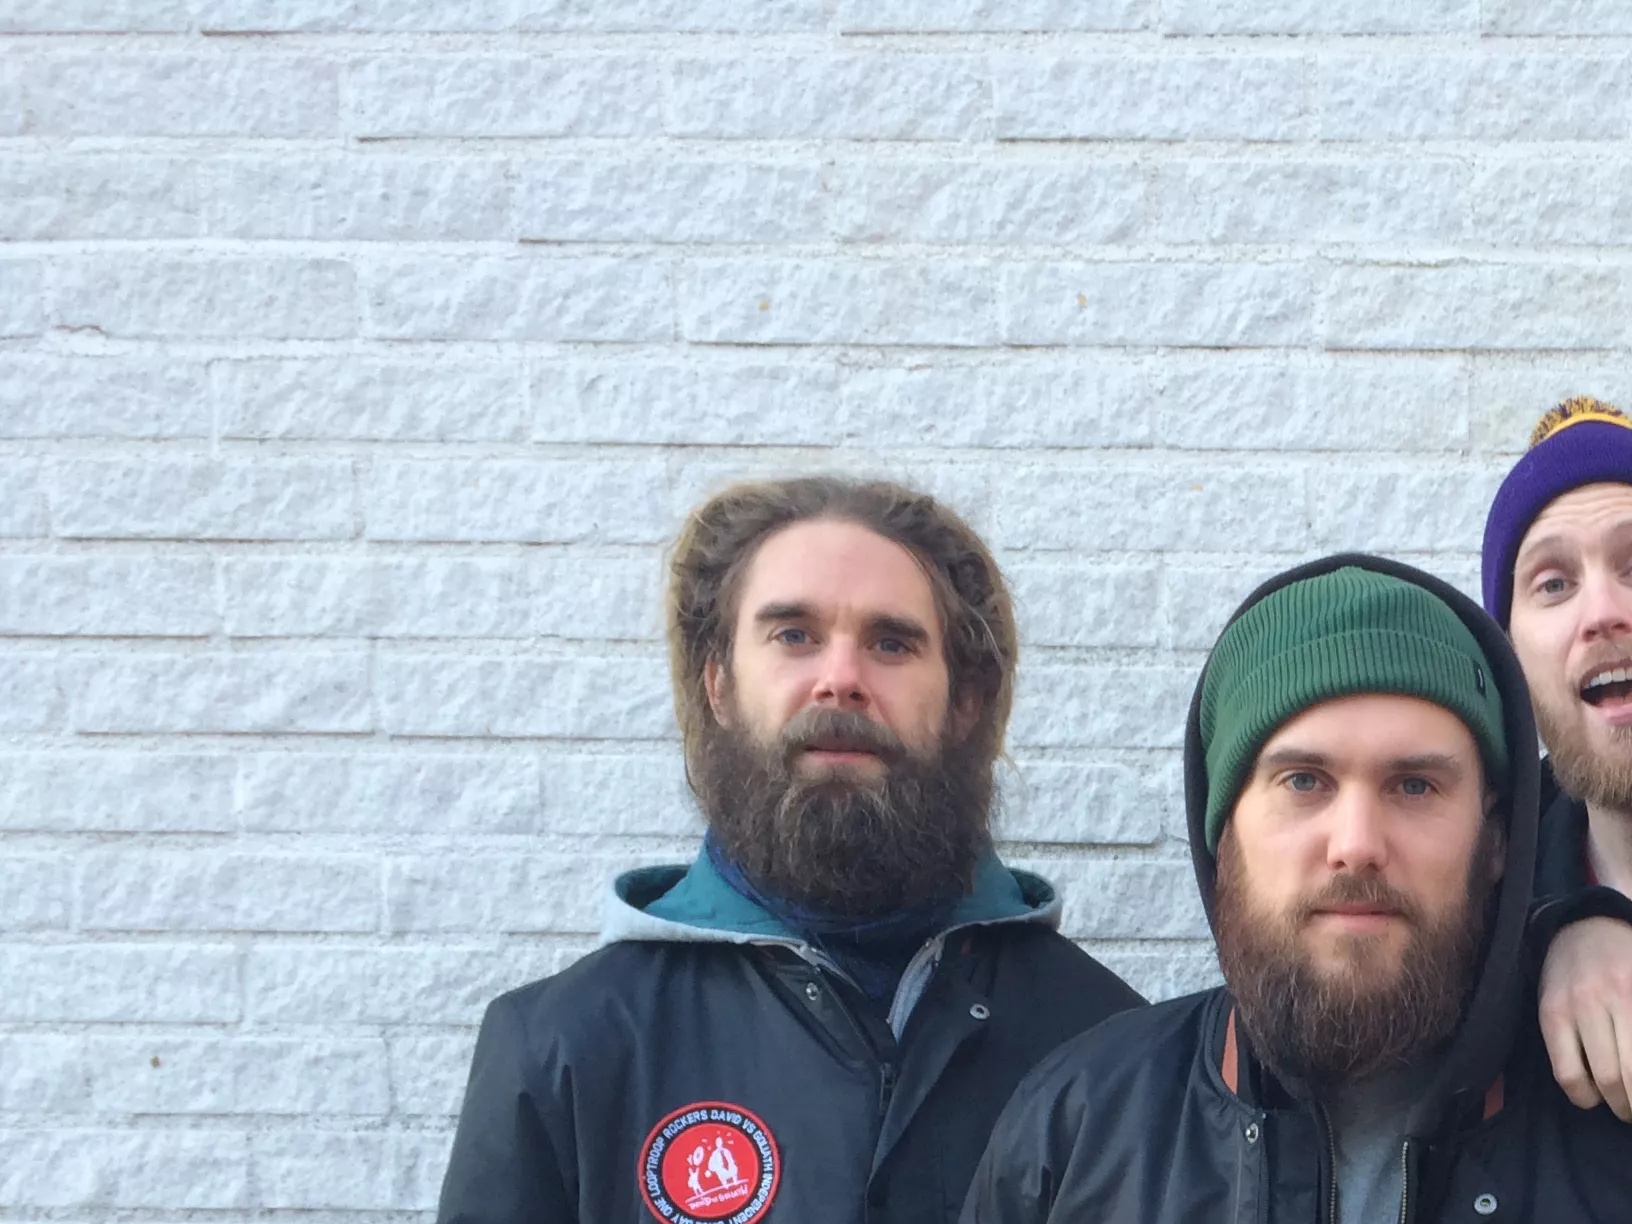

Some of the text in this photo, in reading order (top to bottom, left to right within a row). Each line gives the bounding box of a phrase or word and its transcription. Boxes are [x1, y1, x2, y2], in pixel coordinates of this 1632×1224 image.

[663, 1110, 709, 1139] ROCKERS
[710, 1109, 742, 1125] DAVID
[742, 1119, 755, 1133] VS
[752, 1130, 773, 1172] GOLIATH
[646, 1136, 666, 1196] LOOPTROOP
[655, 1197, 673, 1219] ONE
